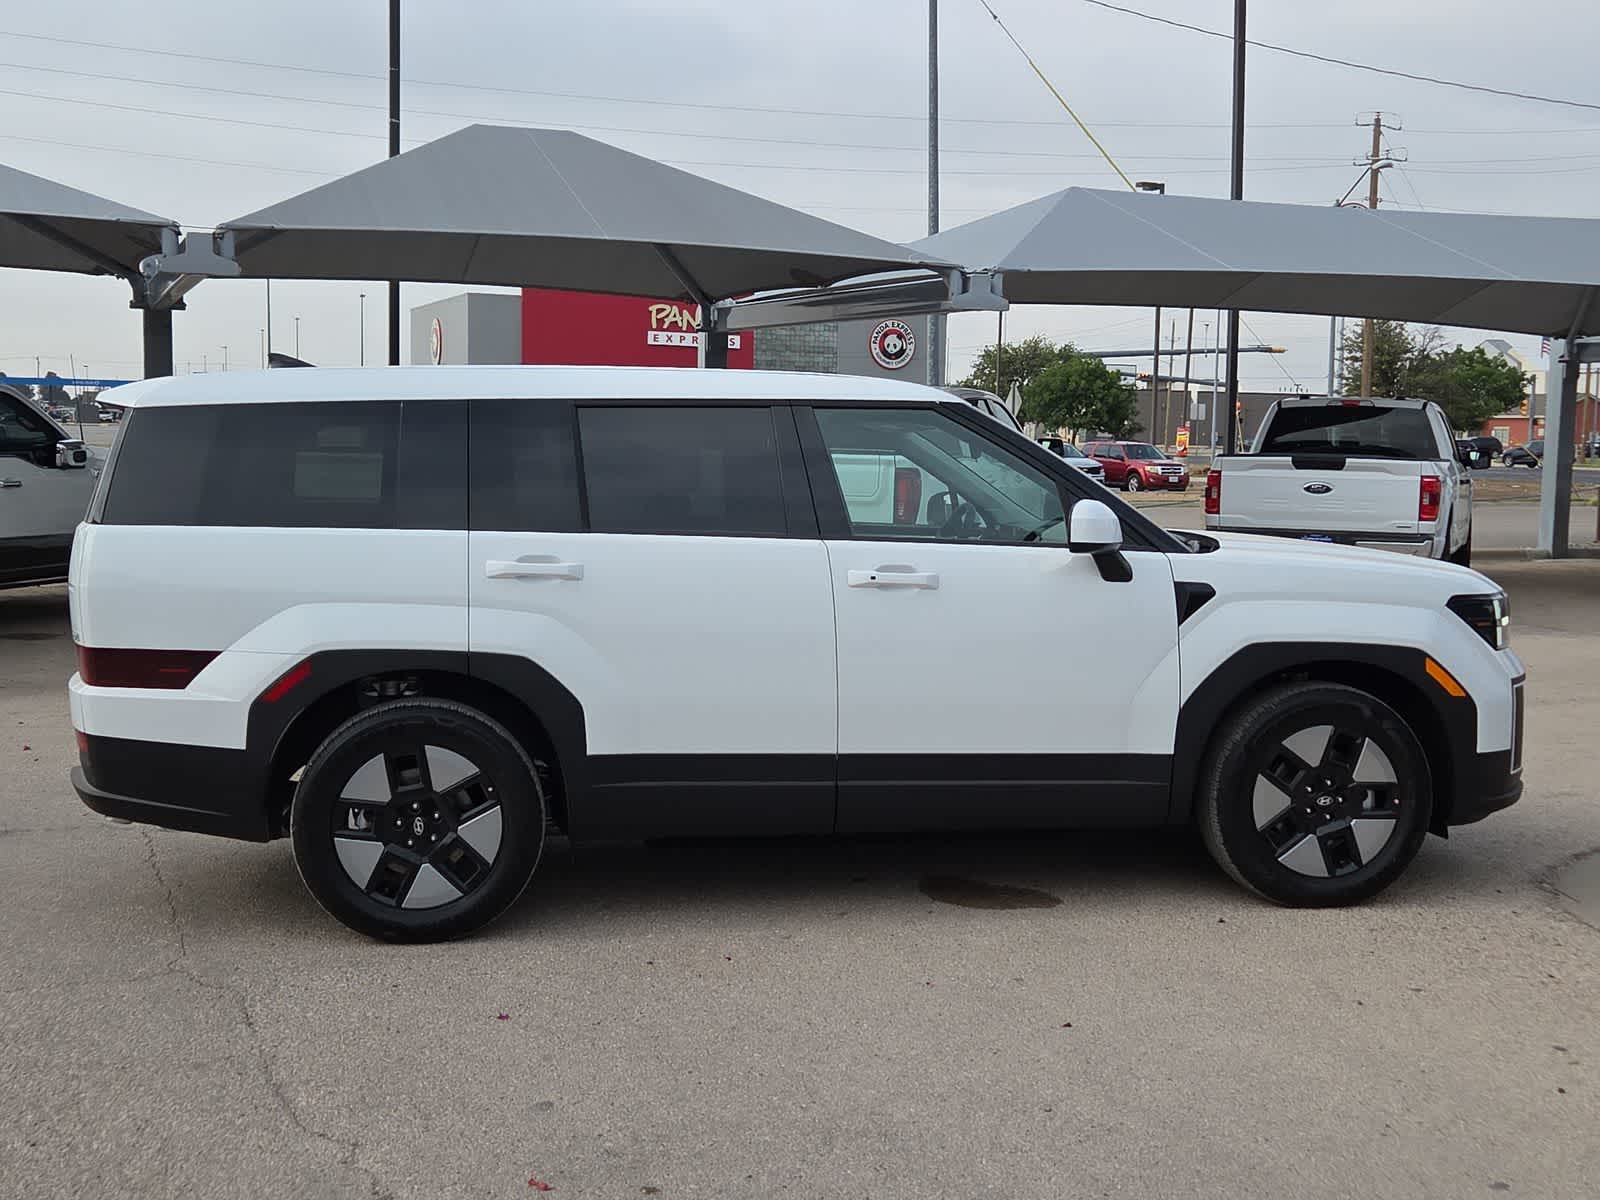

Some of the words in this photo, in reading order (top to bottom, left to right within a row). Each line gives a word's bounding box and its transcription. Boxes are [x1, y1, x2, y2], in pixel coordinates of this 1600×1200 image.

[648, 304, 702, 331] PAN
[653, 333, 736, 347] EXPRS
[872, 322, 890, 345] PANDA
[891, 321, 914, 346] EXPRESS
